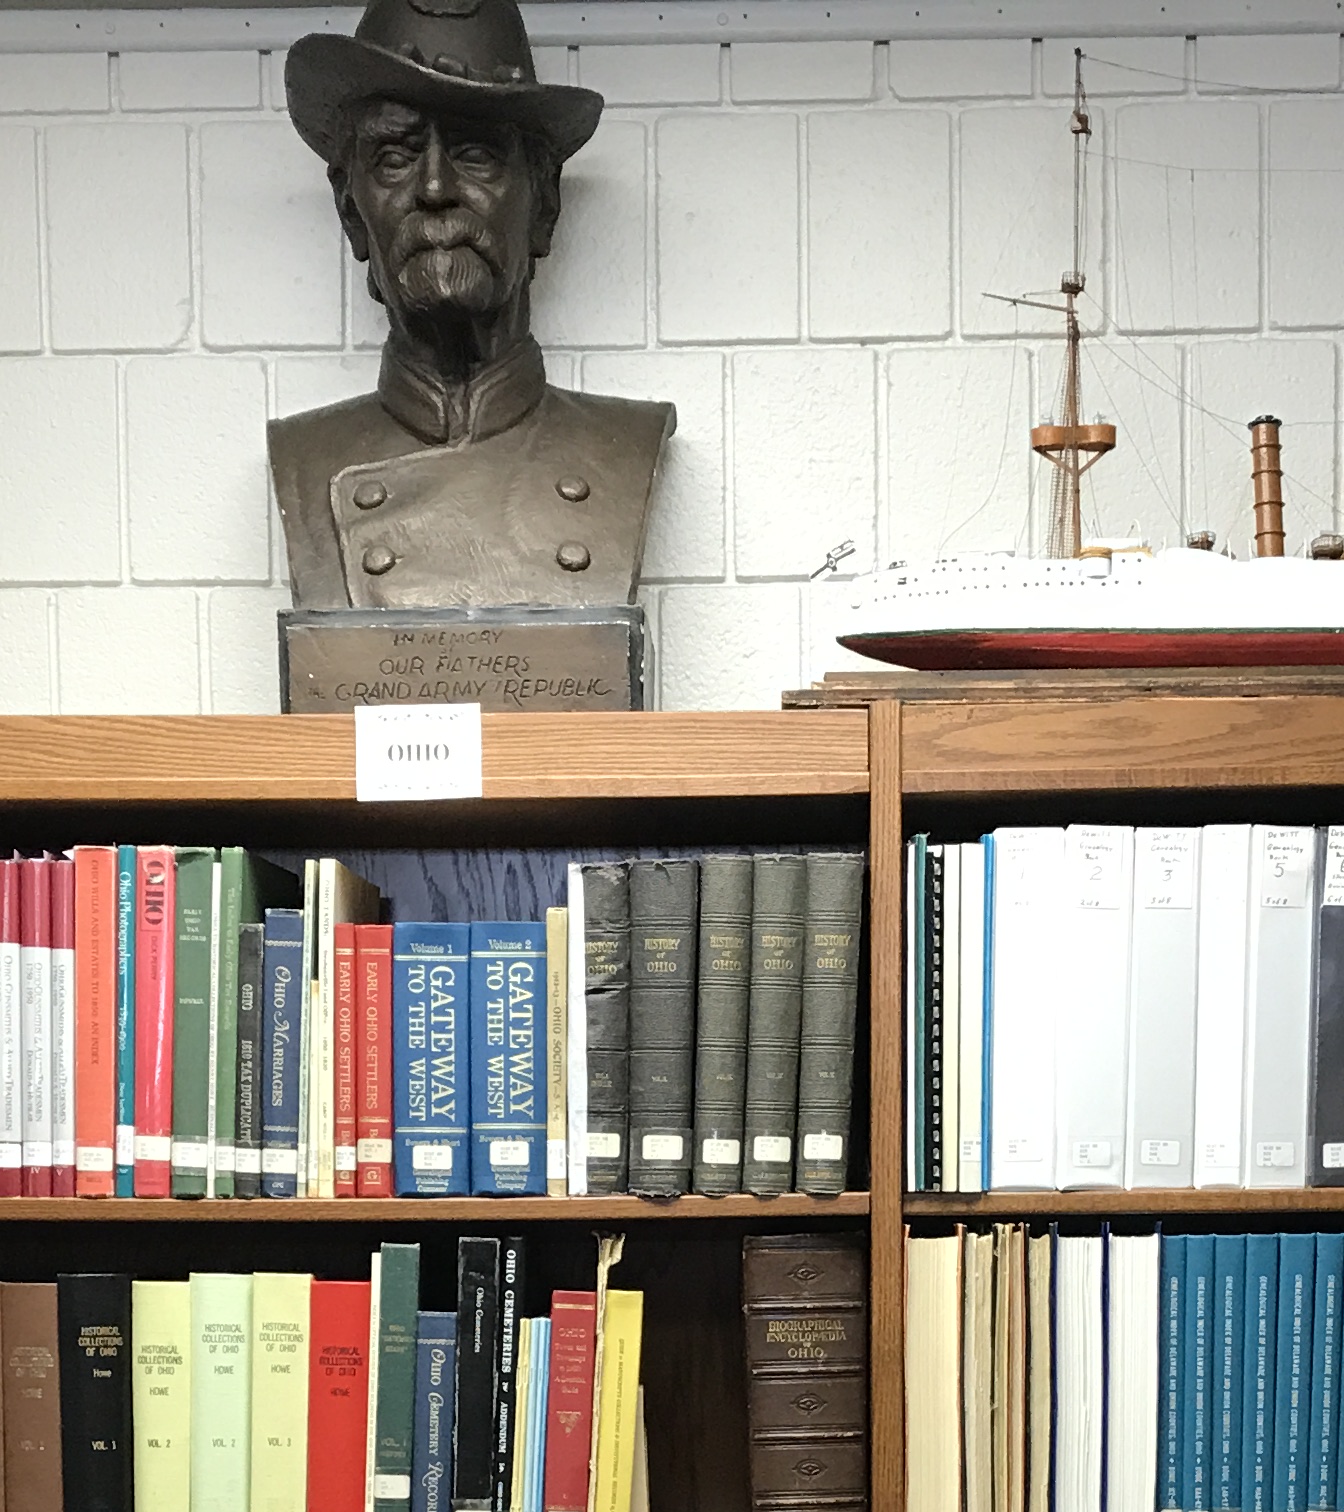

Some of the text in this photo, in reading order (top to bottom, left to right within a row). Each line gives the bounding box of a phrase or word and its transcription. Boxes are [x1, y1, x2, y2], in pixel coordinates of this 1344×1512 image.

[392, 629, 505, 646] IN MEMORY
[378, 655, 530, 677] OUR FATHERS
[335, 678, 613, 706] GRAND ARMY REPUBLIC
[387, 742, 450, 762] OHIO
[91, 860, 99, 884] OHIO
[91, 887, 99, 914] WILLS
[91, 916, 99, 937] AND
[116, 871, 132, 976] Ohio Photographers
[409, 942, 453, 954] Volume 1
[487, 940, 523, 951] Volume
[91, 939, 99, 978] ESTATES
[150, 935, 158, 980] DICK PERRY
[646, 962, 677, 973] OHIO
[711, 960, 741, 972] OHIO
[763, 959, 794, 971] OHIO
[816, 958, 846, 970] OHIO
[241, 983, 254, 1011] OHIO
[339, 961, 351, 1112] EARLY OHIO SETTLERS
[366, 961, 379, 1109] EARLY OHIO SETTLERS
[408, 964, 426, 1121] TO THE WEST
[430, 964, 455, 1122] GATEWAY
[486, 960, 504, 1118] TO THE WEST
[509, 961, 534, 1119] GATEWAY
[91, 1038, 99, 1065] INDEX
[240, 1060, 253, 1082] TAX
[473, 1287, 485, 1353] Ohio Cemeteries
[501, 1249, 517, 1373] OHIO CEMETERIES
[262, 1322, 302, 1333] HISTORICAL
[768, 1319, 845, 1333] BIOGRAPHICAL
[259, 1333, 304, 1343] COLLECTIONS
[266, 1343, 297, 1353] OF OHIO
[137, 1355, 183, 1365] COLLECTIONS
[140, 1345, 179, 1355] HISTORICAL
[270, 1364, 291, 1374] HOWE
[498, 1401, 509, 1453] ADDENDUM
